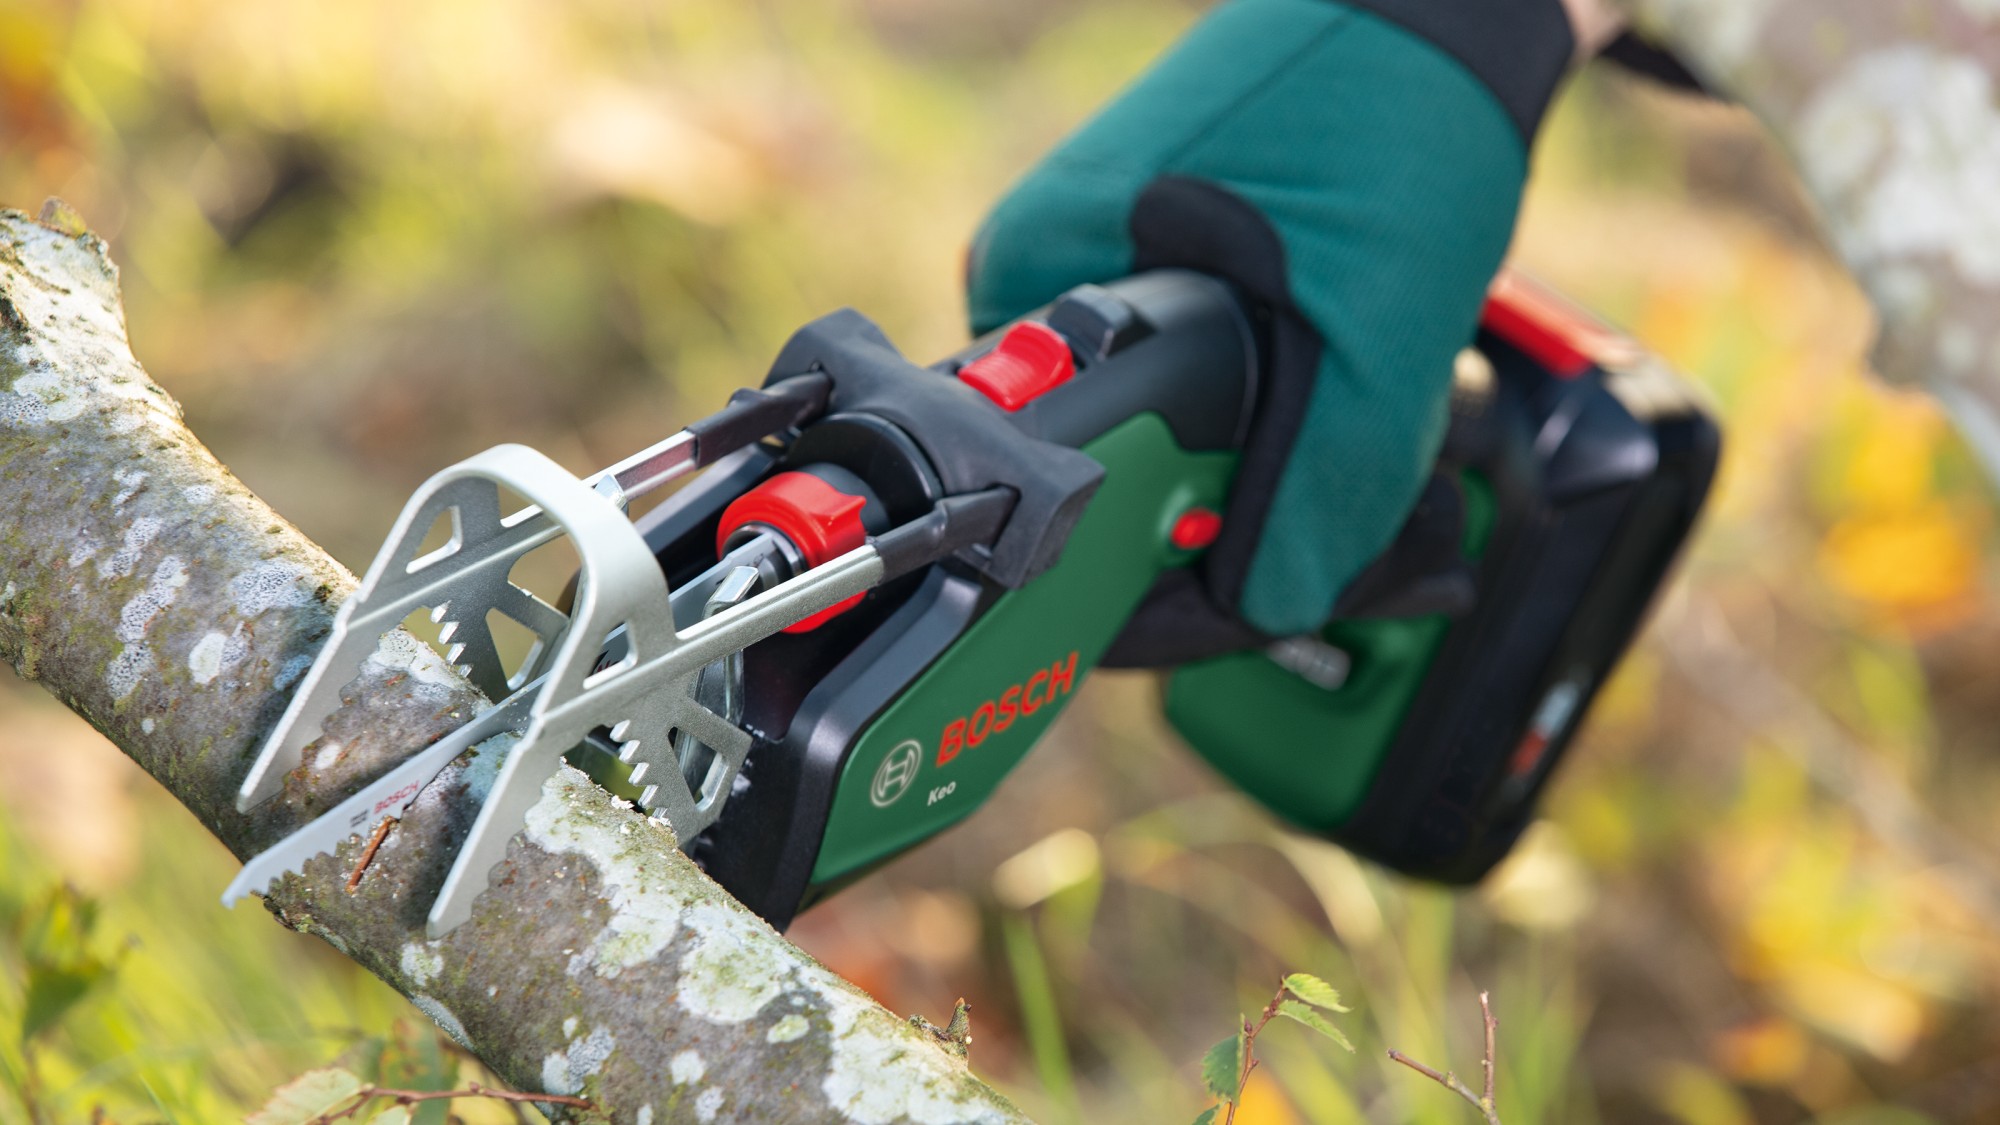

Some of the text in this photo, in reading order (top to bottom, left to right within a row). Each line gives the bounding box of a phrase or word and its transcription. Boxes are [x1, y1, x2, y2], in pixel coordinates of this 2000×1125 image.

[936, 651, 1079, 768] BOSCH
[374, 780, 419, 813] BOSCH
[927, 781, 956, 806] Keo
